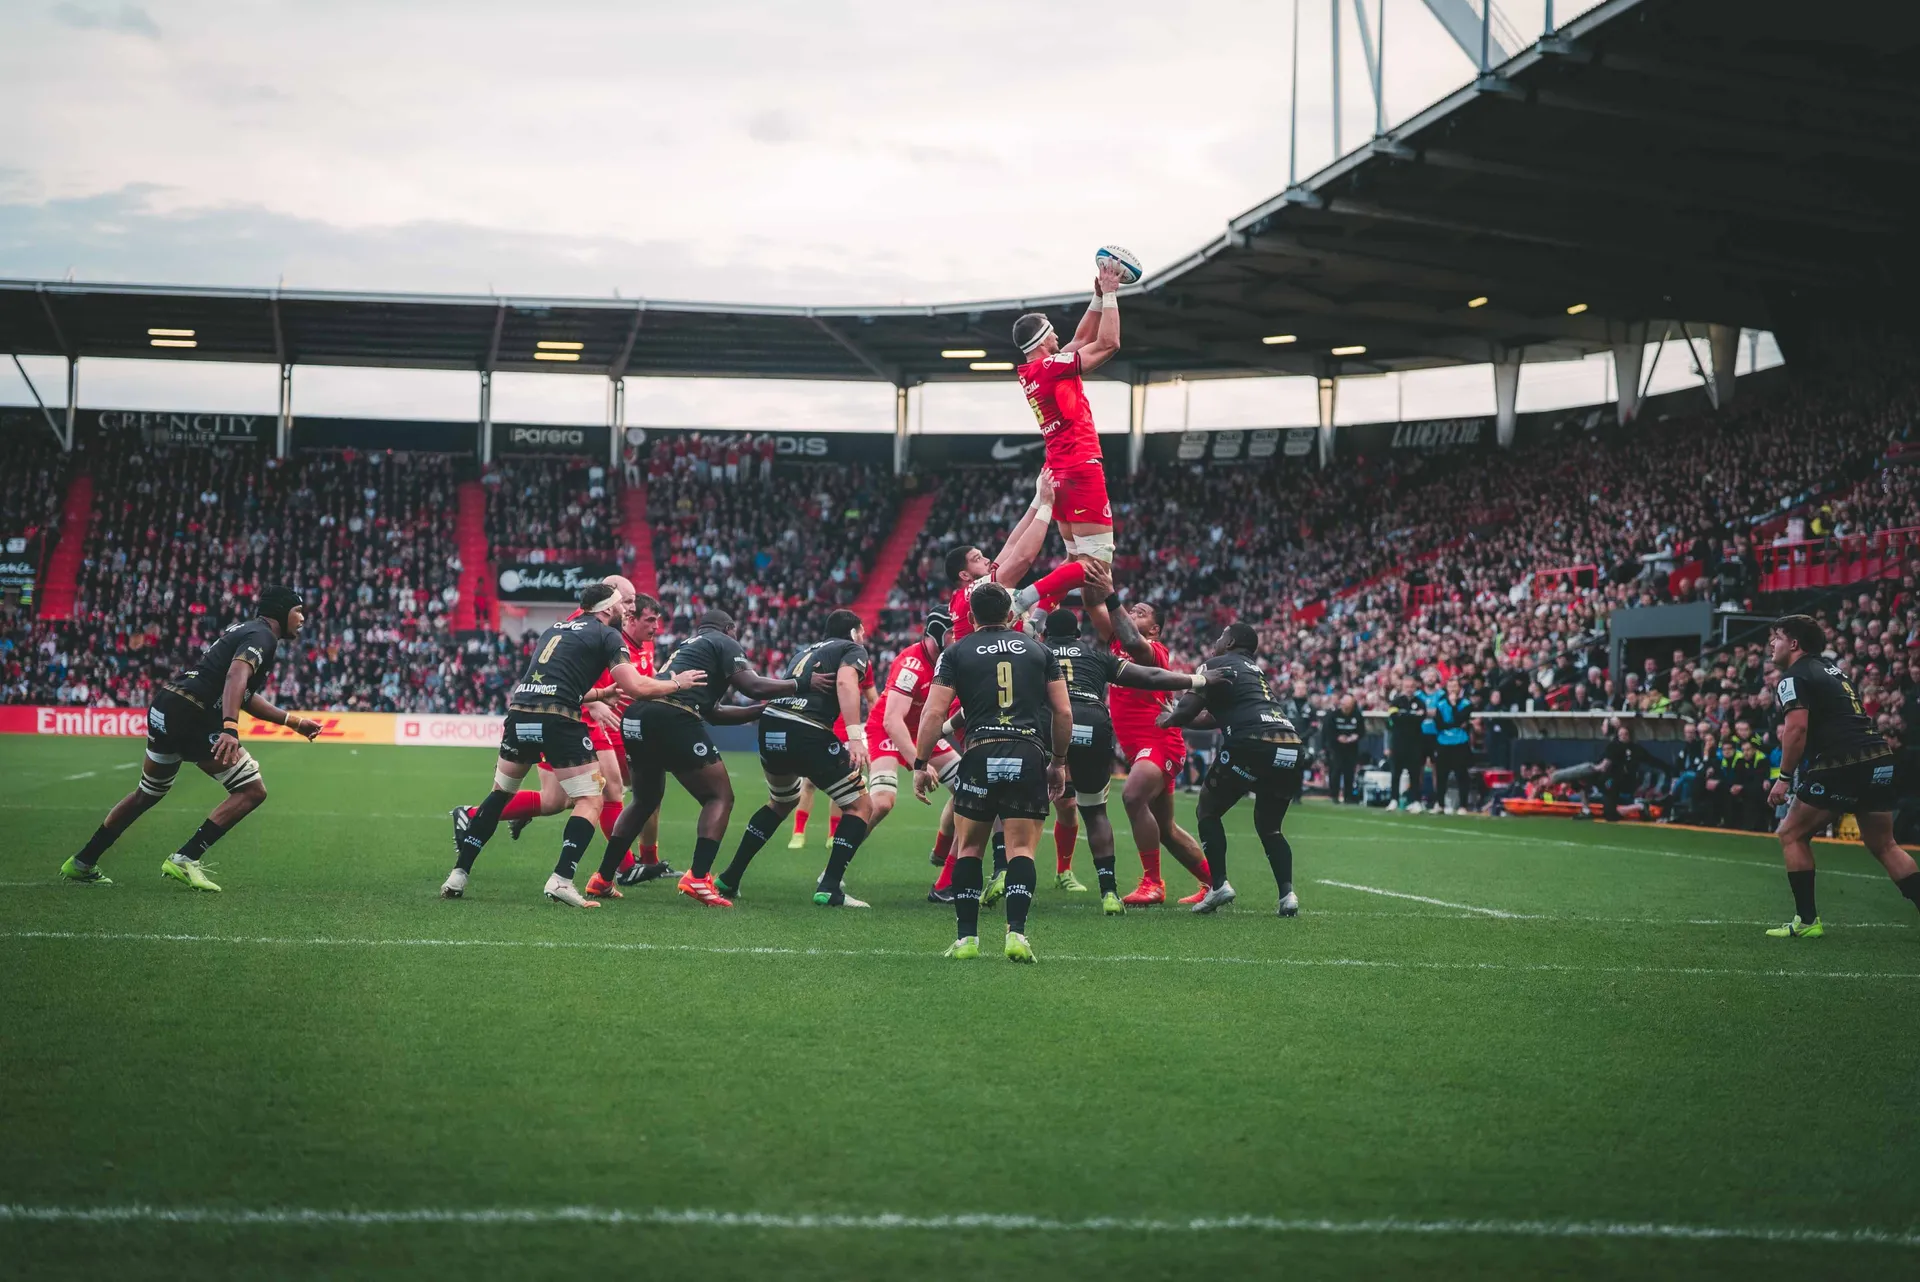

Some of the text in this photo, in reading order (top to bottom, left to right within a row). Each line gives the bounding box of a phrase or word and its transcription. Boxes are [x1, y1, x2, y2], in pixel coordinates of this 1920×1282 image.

[514, 427, 584, 445] Parera
[538, 634, 562, 664] 8
[1052, 646, 1082, 657] ellC
[1058, 658, 1074, 682] 7
[515, 683, 557, 694] OLLYWOOD
[996, 661, 1014, 709] 9
[1272, 759, 1296, 769] SSG
